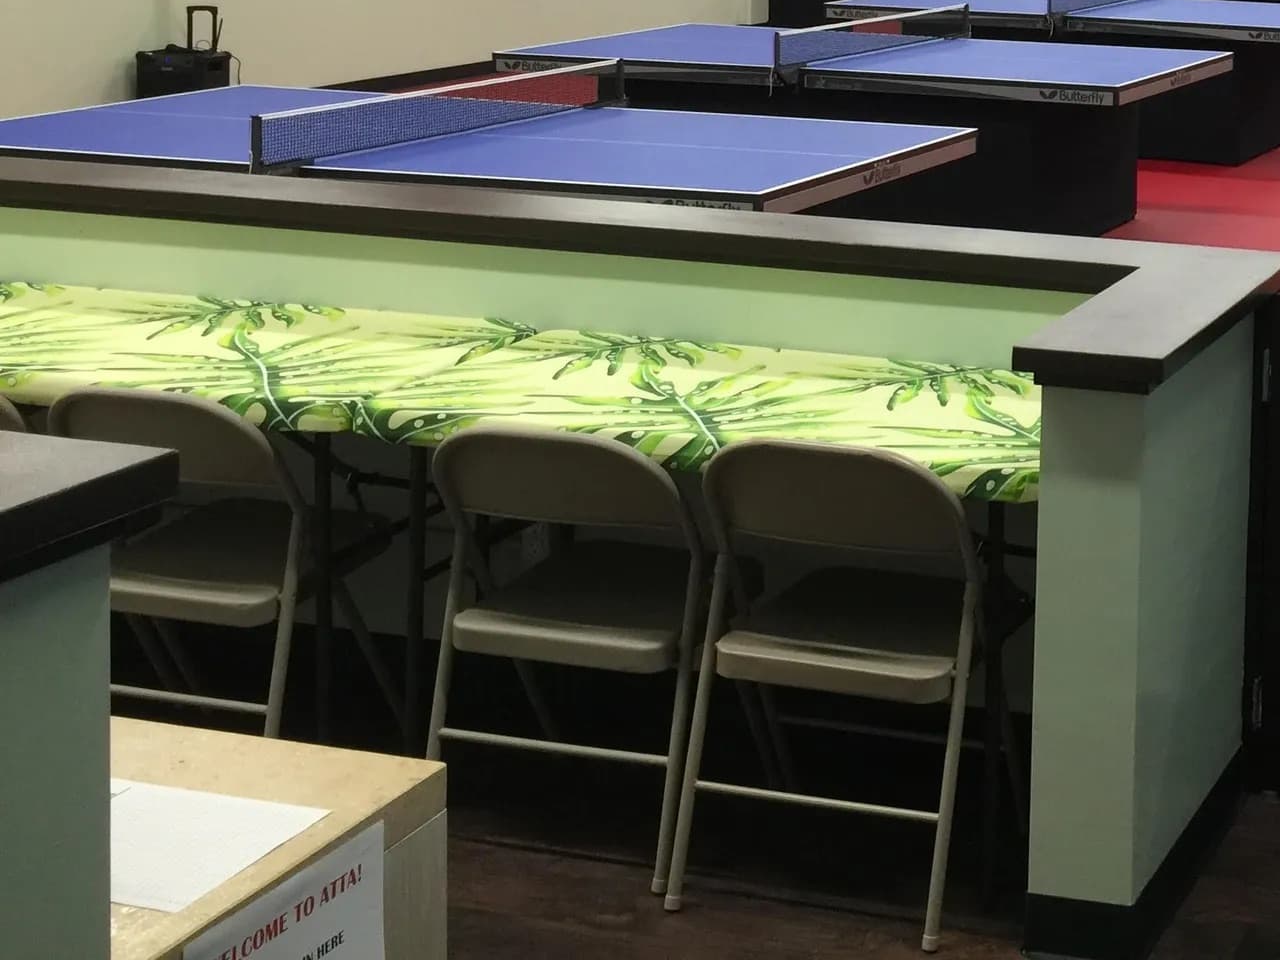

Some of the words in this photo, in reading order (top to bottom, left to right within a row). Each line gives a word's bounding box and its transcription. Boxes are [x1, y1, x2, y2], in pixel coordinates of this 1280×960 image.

[1059, 90, 1105, 105] Butterfly
[215, 912, 288, 960] ELCOME
[293, 895, 315, 923] TO
[320, 864, 362, 907] ATTA!
[317, 929, 345, 959] HERE
